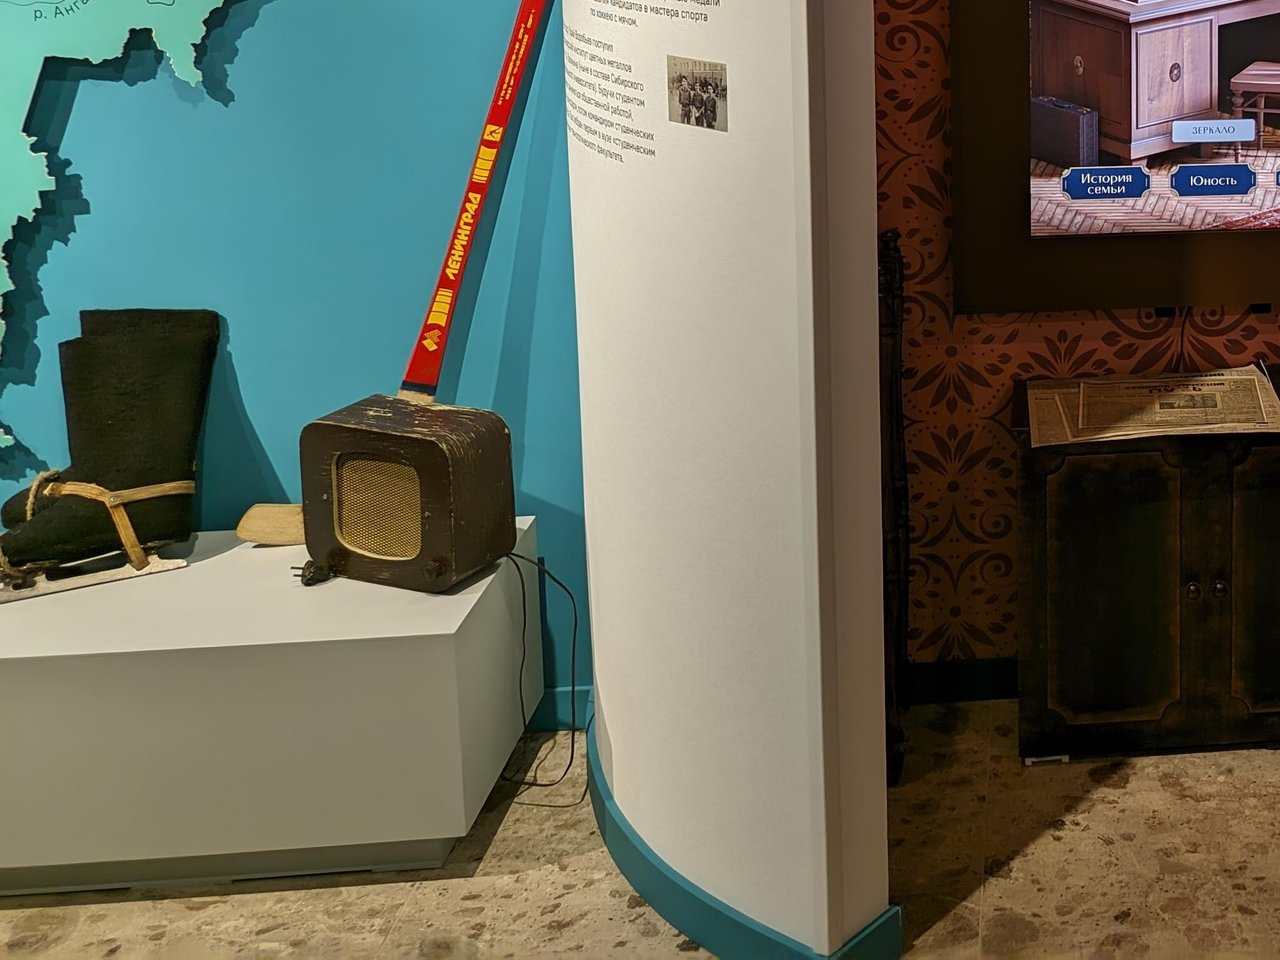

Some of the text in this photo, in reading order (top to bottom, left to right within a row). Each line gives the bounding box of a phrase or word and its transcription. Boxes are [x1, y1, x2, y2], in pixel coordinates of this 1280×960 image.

[34, 9, 47, 21] р.
[648, 5, 708, 22] мастера спорта
[1192, 125, 1236, 135] ЗЕРКАЛО
[1081, 172, 1132, 185] История
[1190, 175, 1237, 187] Юность
[1087, 184, 1126, 195] семьи
[445, 192, 482, 280] ЛЕНИНГРАД
